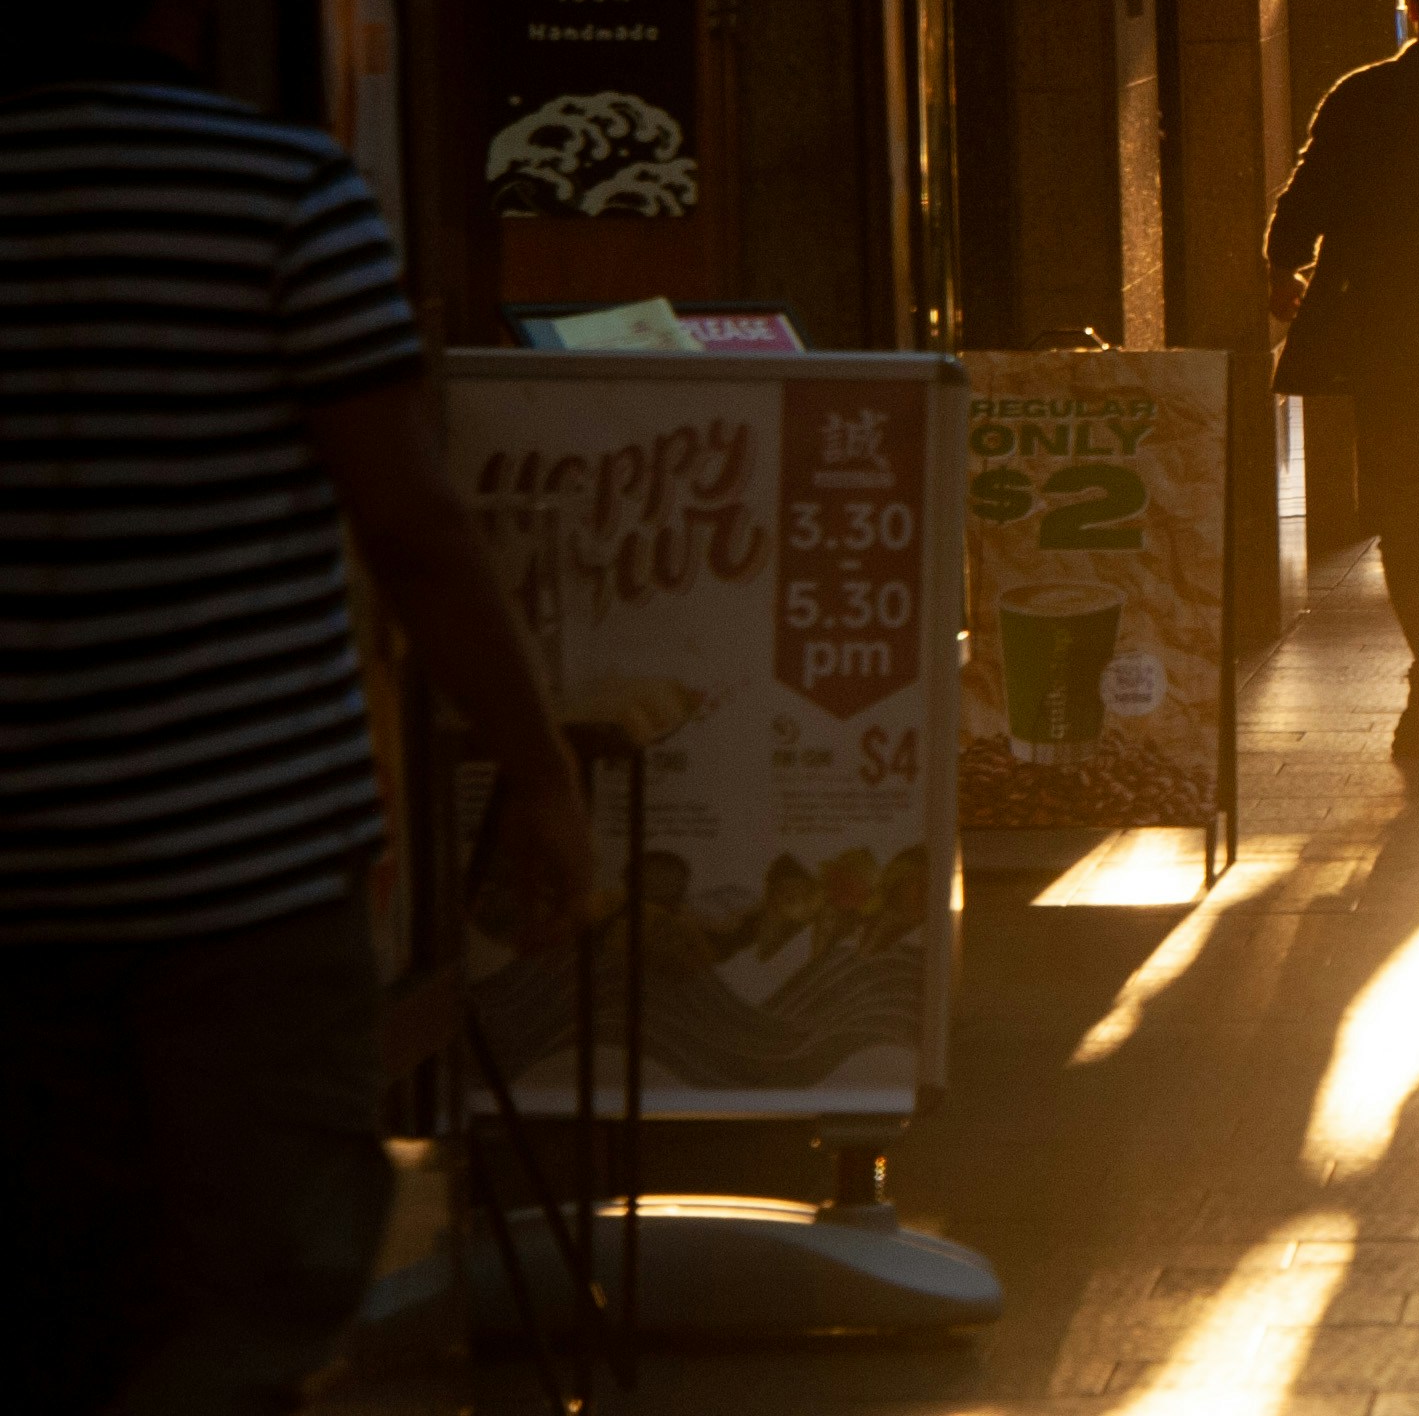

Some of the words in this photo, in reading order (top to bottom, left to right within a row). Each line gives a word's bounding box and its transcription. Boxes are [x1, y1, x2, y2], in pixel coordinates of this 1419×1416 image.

[528, 22, 659, 43] Handmade
[969, 399, 1157, 419] REGULAR
[969, 424, 1156, 458] ONLY
[788, 501, 914, 551] 3.30
[968, 462, 1150, 551] $2
[786, 580, 913, 630] 5.30
[801, 639, 892, 690] pm
[858, 724, 920, 787] $4
